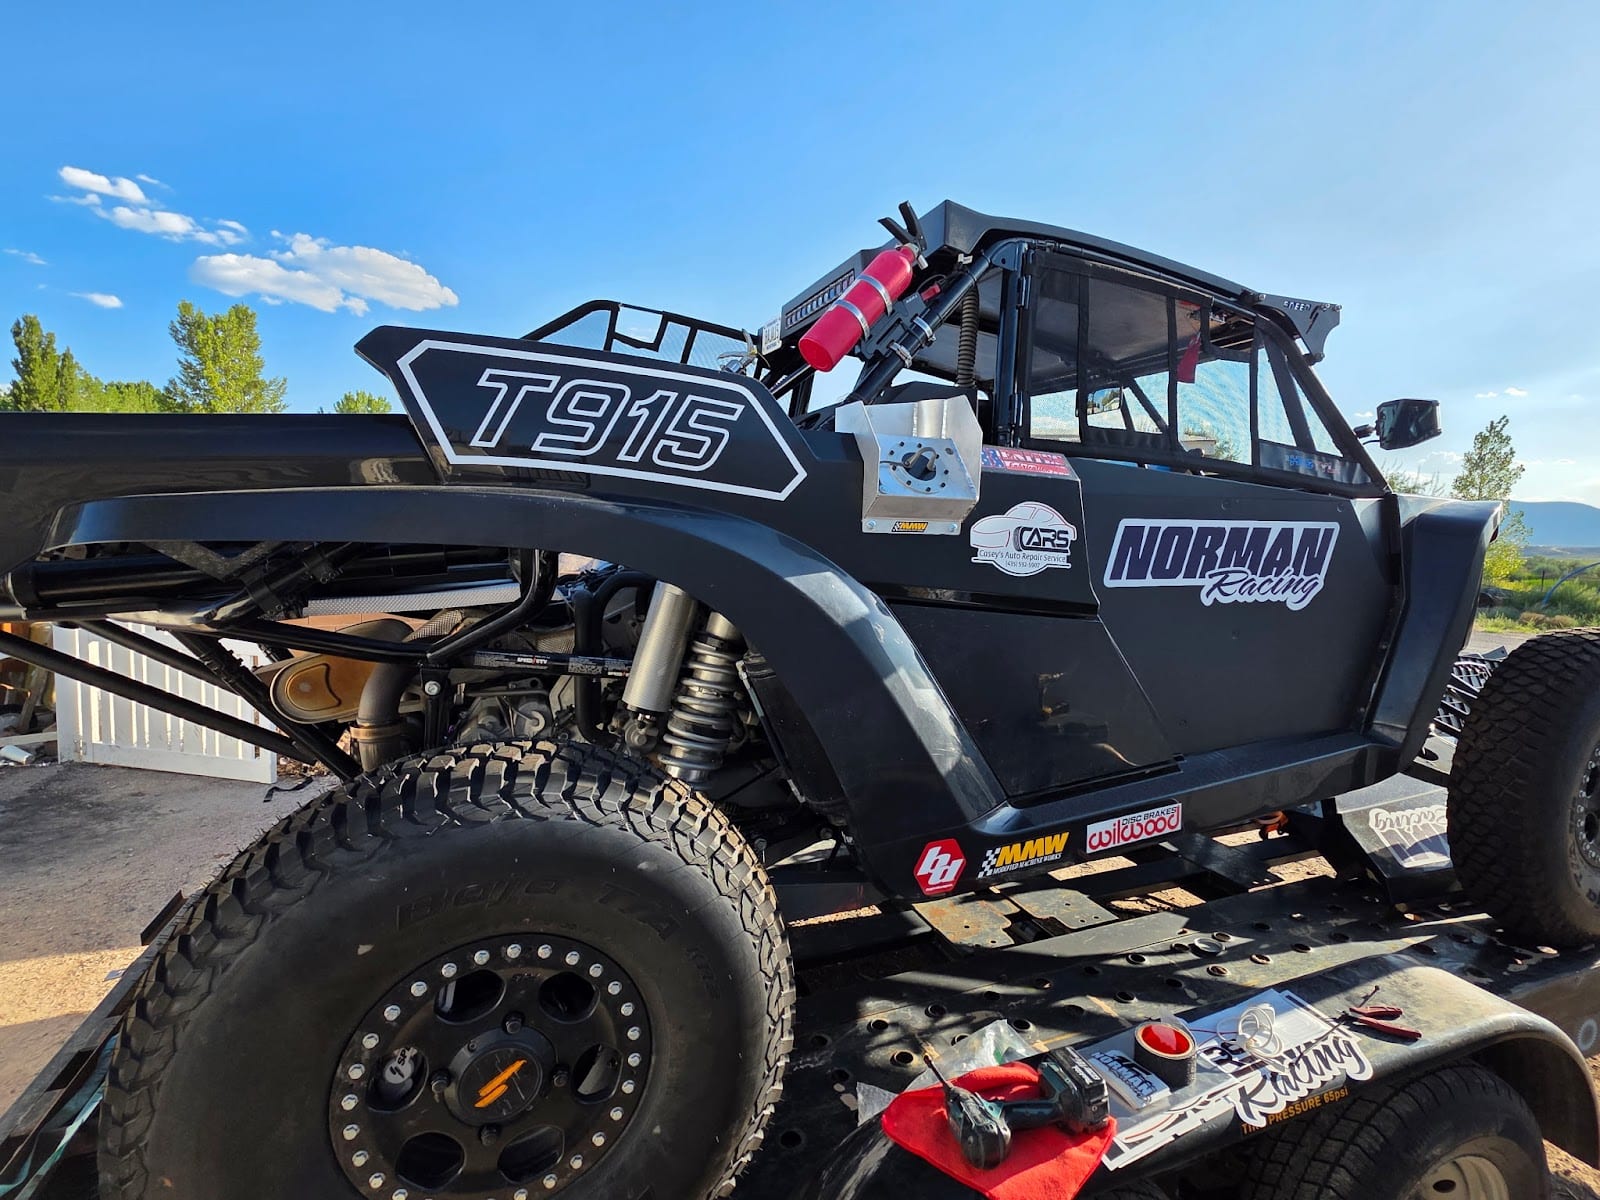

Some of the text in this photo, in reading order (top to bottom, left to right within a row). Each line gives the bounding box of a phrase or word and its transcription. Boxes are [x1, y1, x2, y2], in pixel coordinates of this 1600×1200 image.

[469, 367, 745, 472] T915
[1005, 551, 1020, 560] Auto
[1023, 553, 1042, 562] Repair
[1044, 554, 1066, 563] Service
[1018, 526, 1069, 553] CARS
[1109, 525, 1337, 581] NORMAN
[1204, 569, 1320, 605] Racing
[1088, 804, 1180, 851] wilwood
[1122, 806, 1177, 826] DISC BRAKES
[996, 832, 1069, 867] MMW
[1091, 1052, 1154, 1097] NORMAN
[1238, 1036, 1367, 1121] Racing
[1267, 1095, 1321, 1124] PRESSURE
[1324, 1087, 1349, 1104] 65psi
